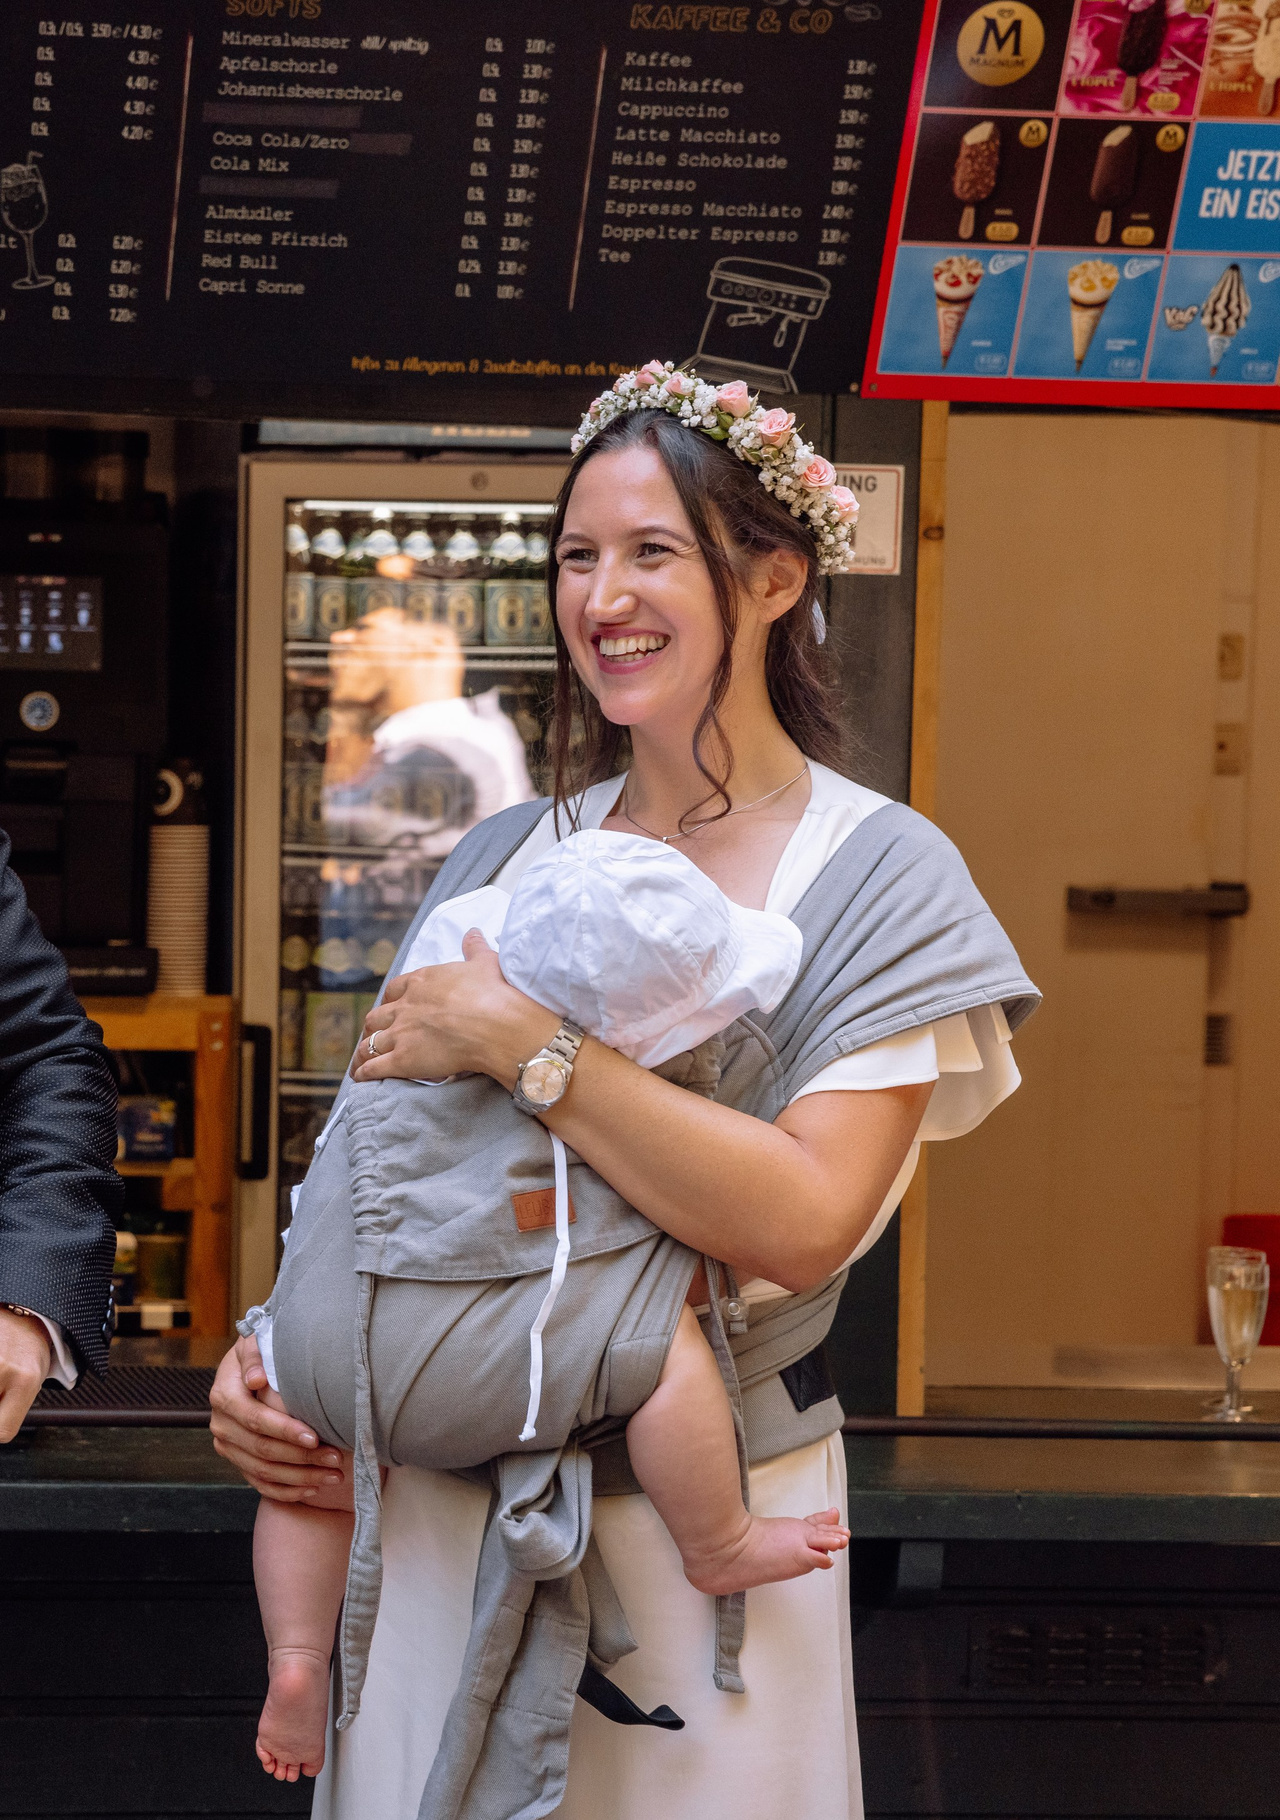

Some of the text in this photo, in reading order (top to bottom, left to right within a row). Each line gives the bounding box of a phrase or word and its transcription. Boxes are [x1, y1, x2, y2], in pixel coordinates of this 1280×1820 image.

[226, 0, 321, 19] SOFTS
[630, 4, 833, 34] KAFFEE & CO
[222, 31, 350, 50] Mineralwasser
[977, 15, 1022, 56] M
[219, 56, 338, 75] Apfelschorle
[624, 52, 692, 68] Kaffee
[218, 81, 403, 102] Johannisbeerschorle
[620, 77, 744, 94] Milchkaffee
[618, 102, 729, 120] Cappuccino
[213, 131, 253, 148] Coca
[260, 132, 350, 151] Cola/Zero
[615, 126, 670, 143] Latte
[680, 128, 781, 145] Macchiato
[210, 155, 250, 172] Cola
[258, 157, 289, 173] Mix
[611, 151, 666, 167] Heiße
[678, 153, 788, 169] Schokolade
[608, 175, 696, 193] Espresso
[205, 205, 294, 222] Almdudler
[604, 200, 693, 217] Espresso
[702, 202, 802, 219] Macchiato
[204, 230, 263, 247] Eistee
[271, 232, 348, 248] Pfirsich
[601, 224, 700, 242] Doppelter
[710, 226, 799, 244] Espresso
[201, 254, 232, 270] Red
[239, 255, 278, 270] Bull
[598, 248, 631, 263] Tee
[199, 278, 247, 297] Capri
[255, 280, 306, 296] Sonne
